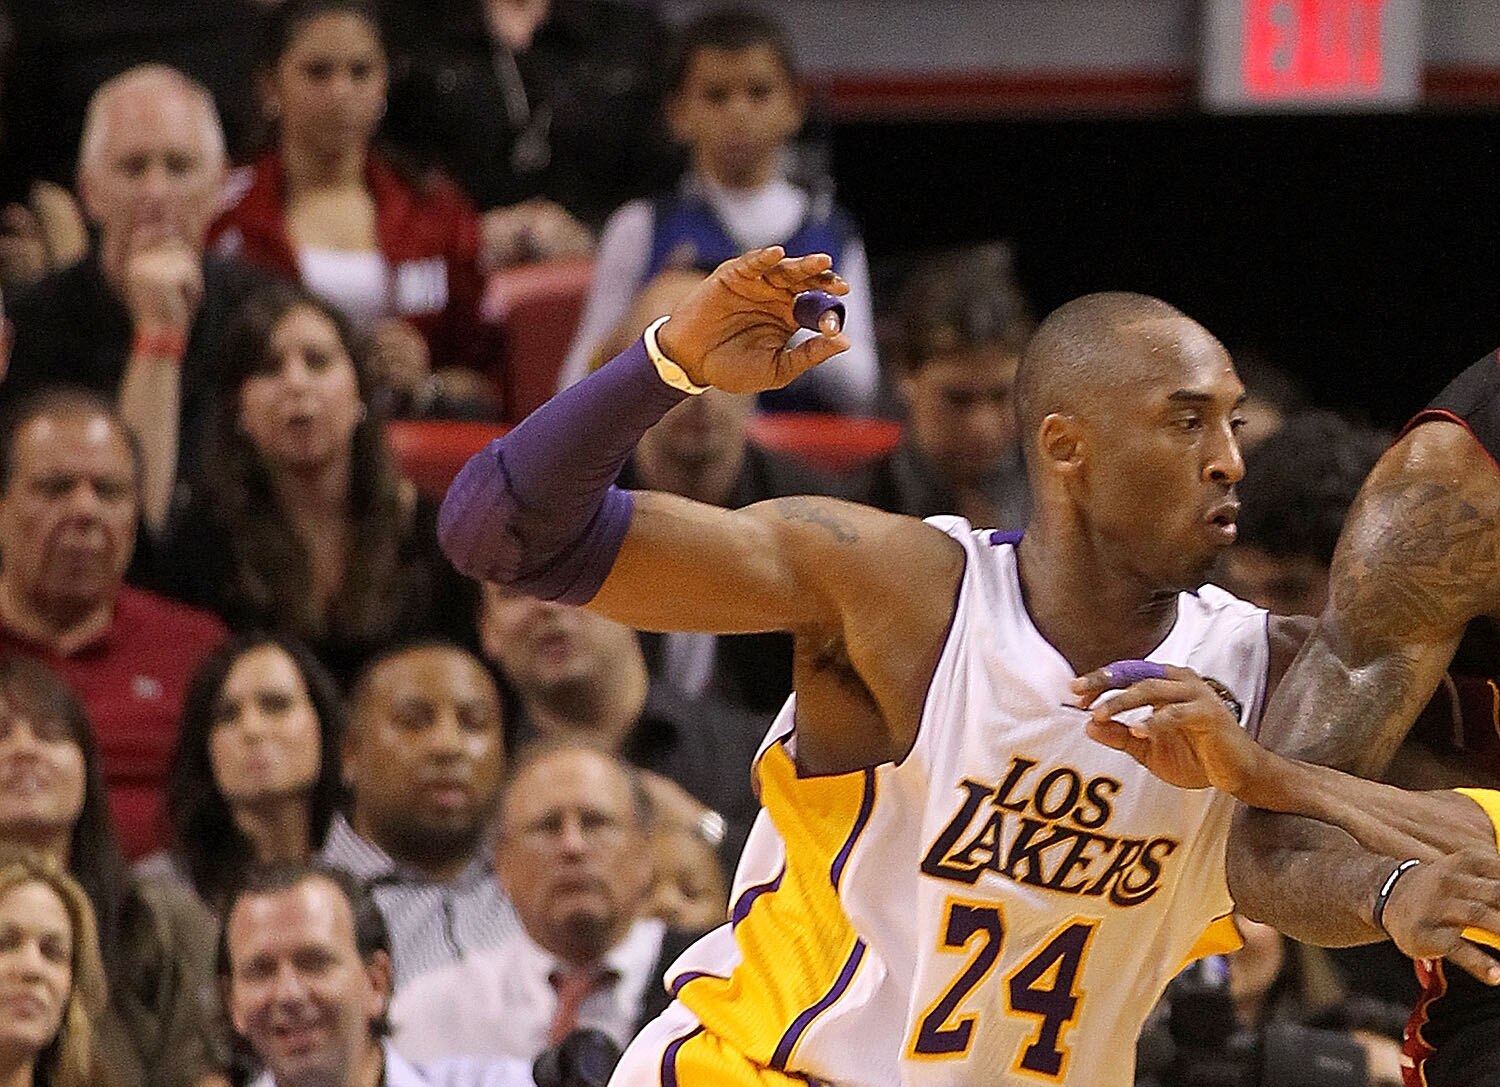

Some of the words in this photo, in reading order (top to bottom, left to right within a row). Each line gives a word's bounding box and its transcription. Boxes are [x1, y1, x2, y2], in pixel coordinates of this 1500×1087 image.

[919, 776, 1180, 908] LAKERS
[993, 757, 1123, 830] LOS
[904, 895, 1101, 1085] 24
